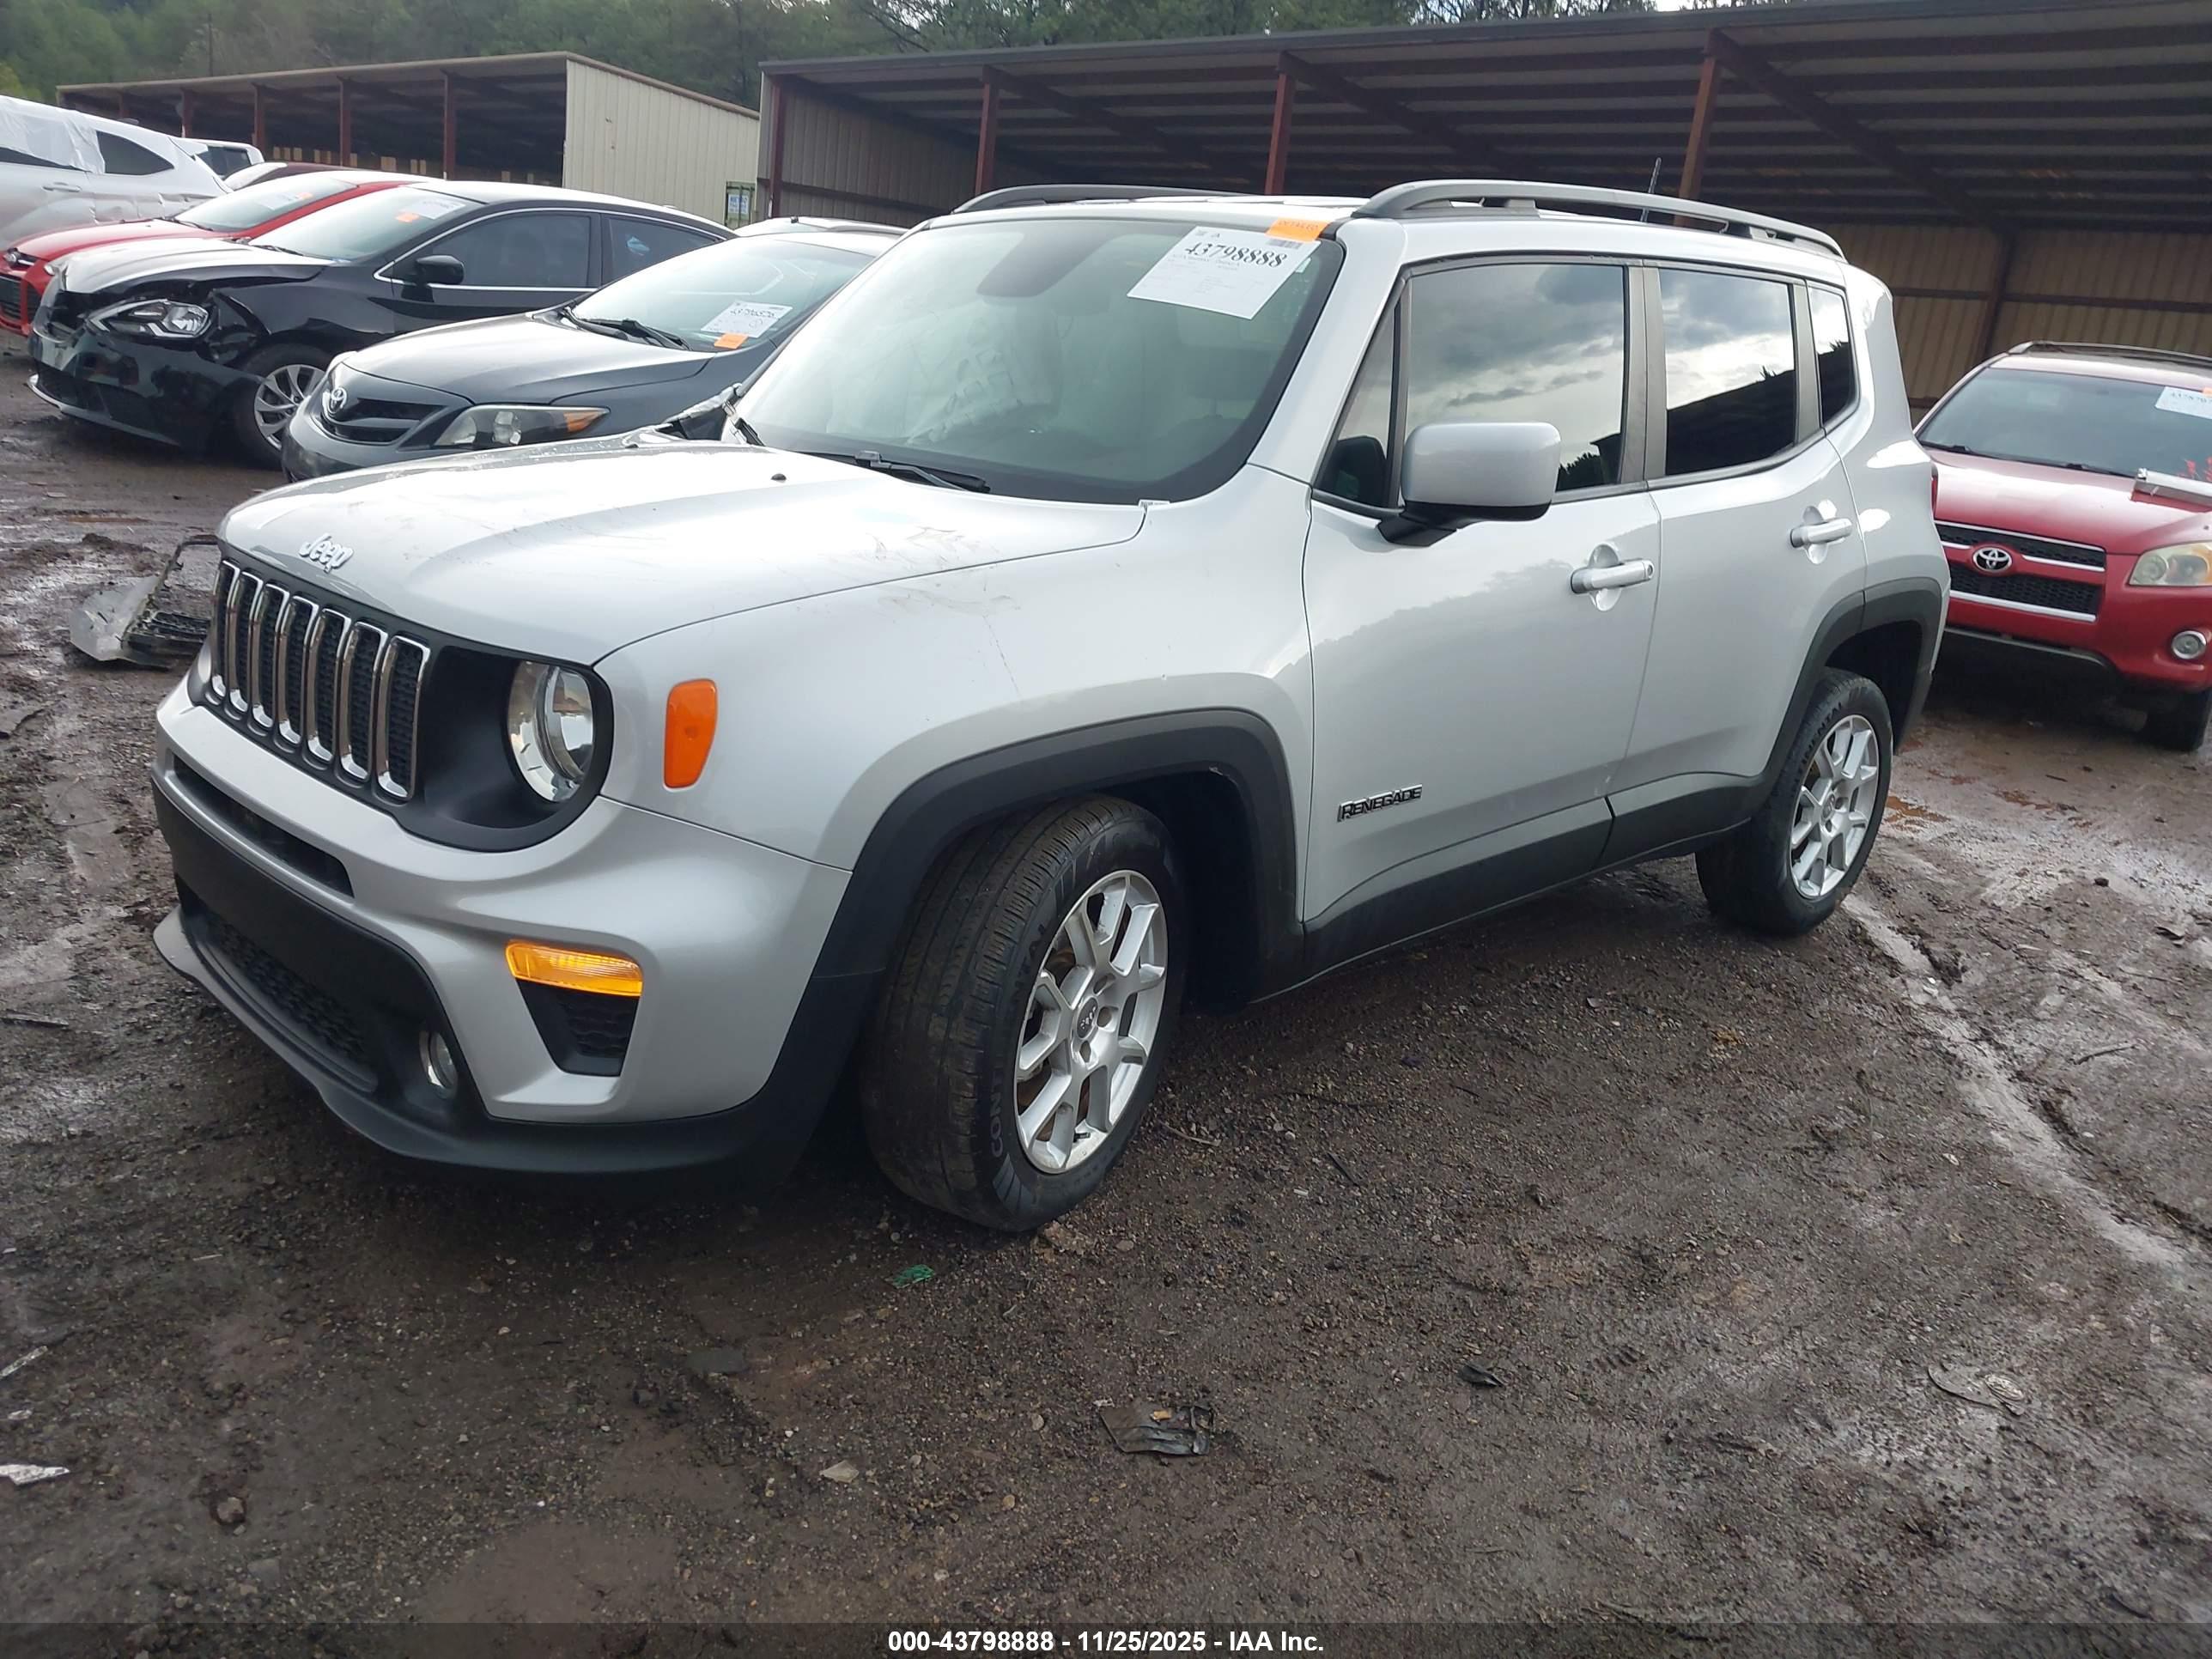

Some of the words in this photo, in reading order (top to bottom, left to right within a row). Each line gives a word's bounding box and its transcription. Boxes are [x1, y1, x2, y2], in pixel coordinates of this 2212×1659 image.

[1185, 241, 1287, 268] 43798888
[299, 532, 354, 574] Jeep
[1337, 783, 1423, 823] RENEGADE
